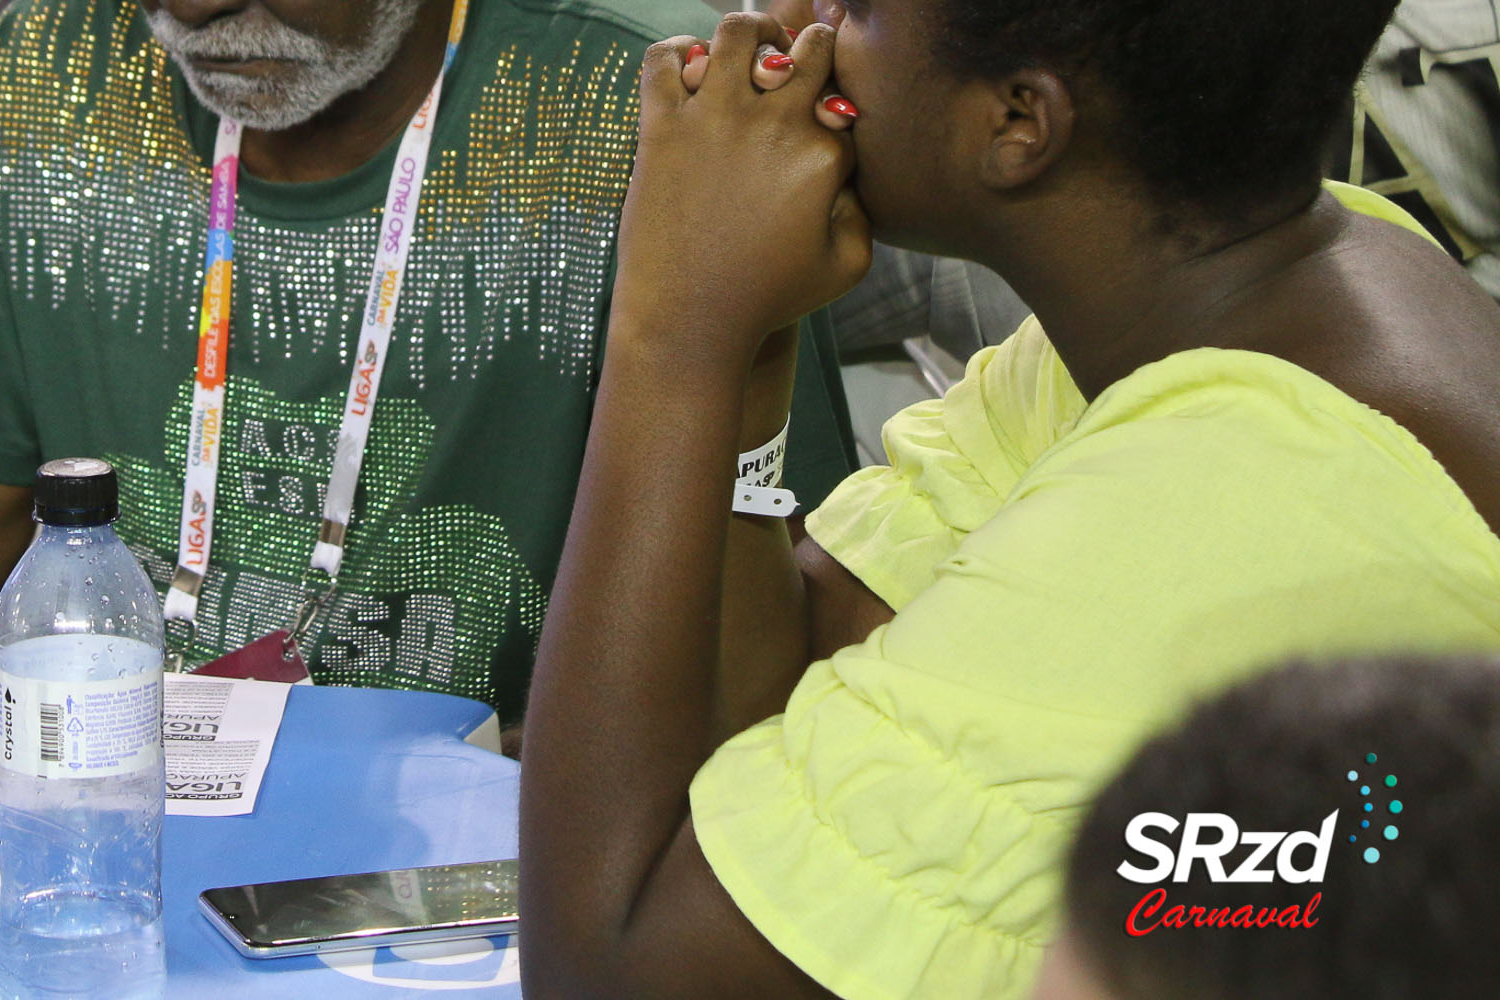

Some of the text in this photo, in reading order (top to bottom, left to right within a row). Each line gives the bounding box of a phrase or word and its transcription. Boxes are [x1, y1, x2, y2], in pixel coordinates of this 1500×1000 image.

[385, 156, 417, 255] SÃO PAULO
[212, 230, 227, 296] ESCOLAS
[210, 296, 222, 325] DAS
[204, 326, 220, 379] DESFILE
[4, 705, 15, 760] crystal
[165, 781, 242, 793] LIGA
